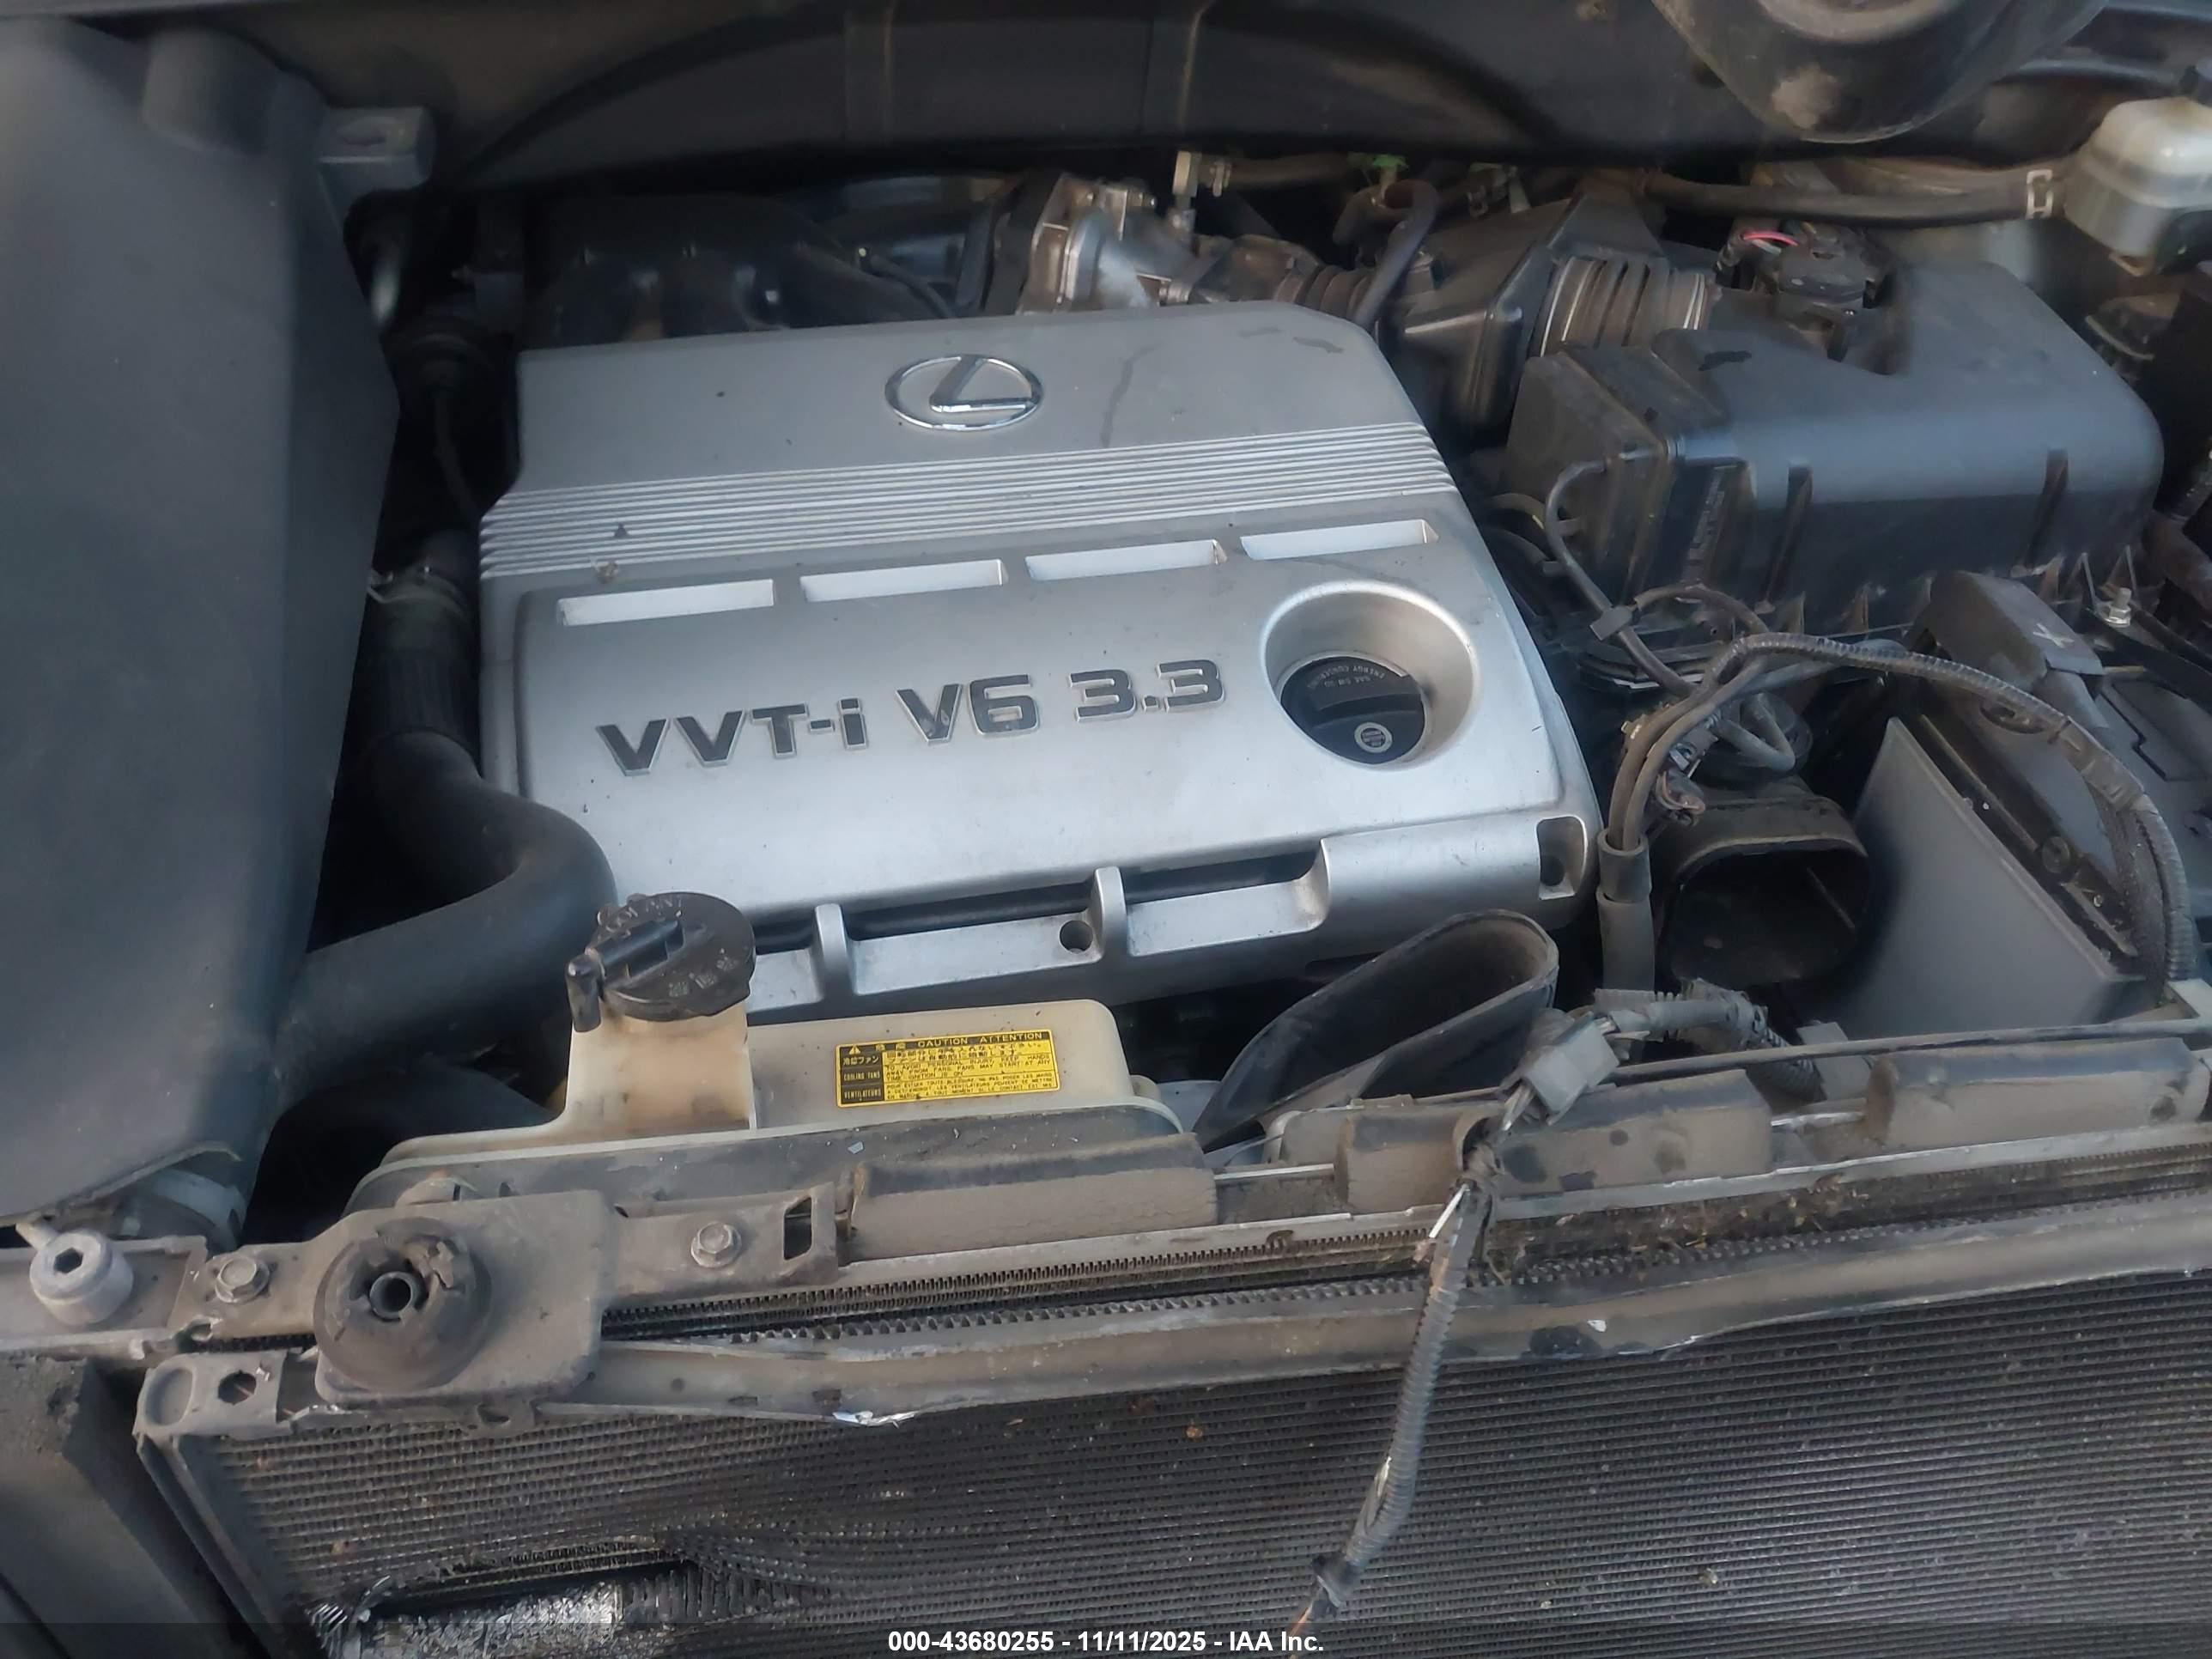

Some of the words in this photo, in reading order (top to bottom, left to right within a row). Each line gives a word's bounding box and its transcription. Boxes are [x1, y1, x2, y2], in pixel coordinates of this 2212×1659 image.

[596, 696, 867, 777] VVT-i
[895, 673, 1039, 744] V6
[1068, 658, 1226, 724] 3.3
[917, 1037, 967, 1048] CAUTION
[980, 1032, 1042, 1042] ATTENTION
